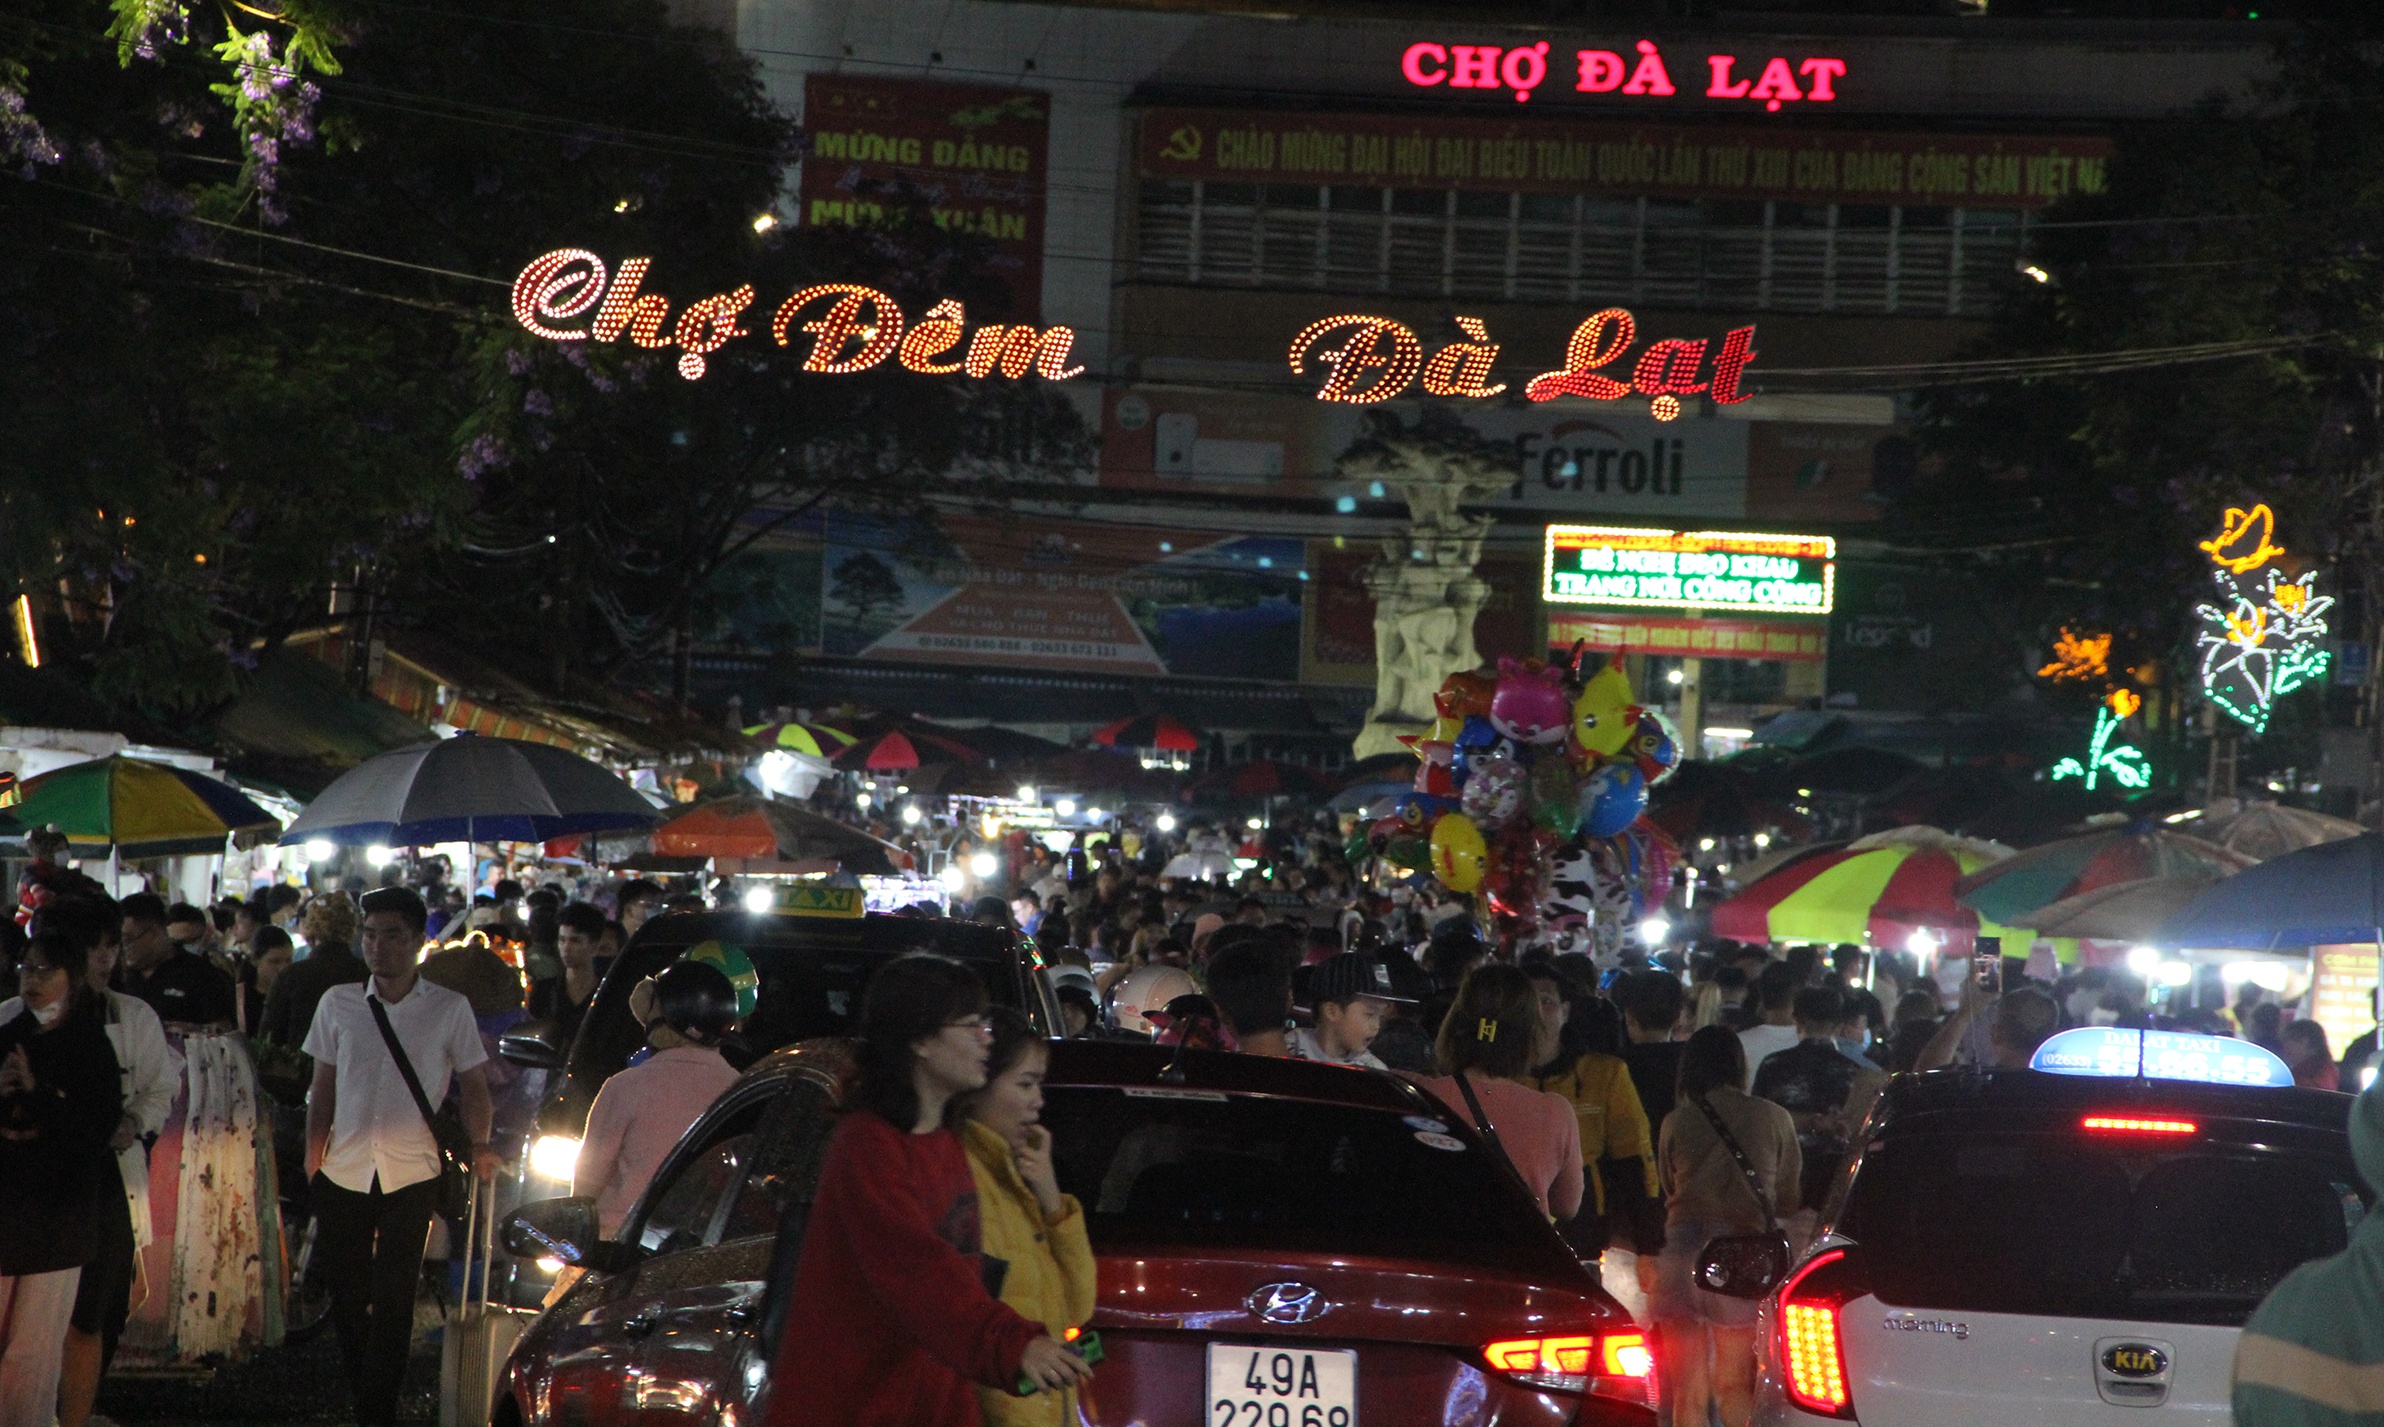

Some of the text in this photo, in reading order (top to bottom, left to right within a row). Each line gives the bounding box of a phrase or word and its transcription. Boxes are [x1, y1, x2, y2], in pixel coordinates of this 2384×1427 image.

[1401, 39, 1847, 113] CHỢ ĐÀ LẠT
[511, 248, 1757, 422] Chợ Đêm Đà Lạt
[2175, 1036, 2221, 1053] TAXI
[1883, 1317, 1970, 1340] morning
[1245, 1352, 1319, 1399] 49A
[2114, 1350, 2156, 1370] KIA
